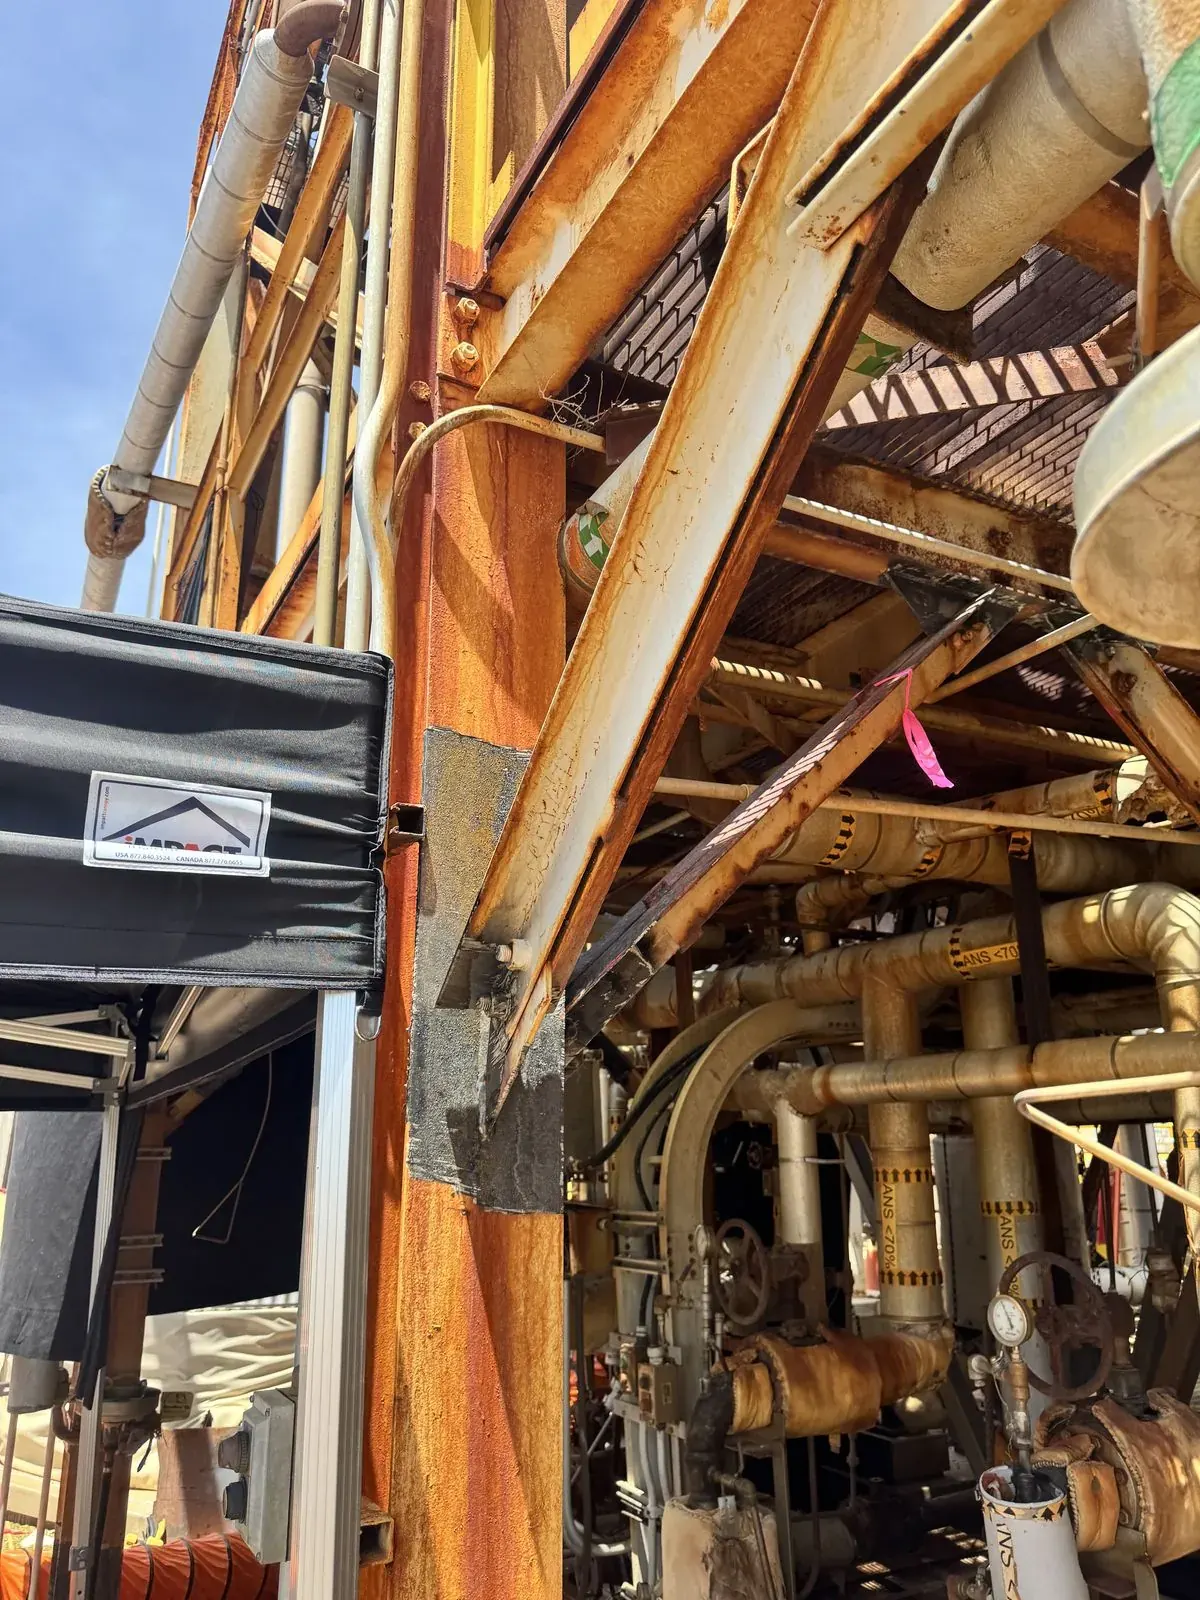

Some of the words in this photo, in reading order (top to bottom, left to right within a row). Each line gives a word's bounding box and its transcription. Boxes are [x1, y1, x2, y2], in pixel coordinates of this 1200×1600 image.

[963, 950, 992, 966] ANS
[883, 1183, 894, 1219] ANS
[885, 1224, 896, 1269] <70%
[1000, 1216, 1014, 1250] ANS
